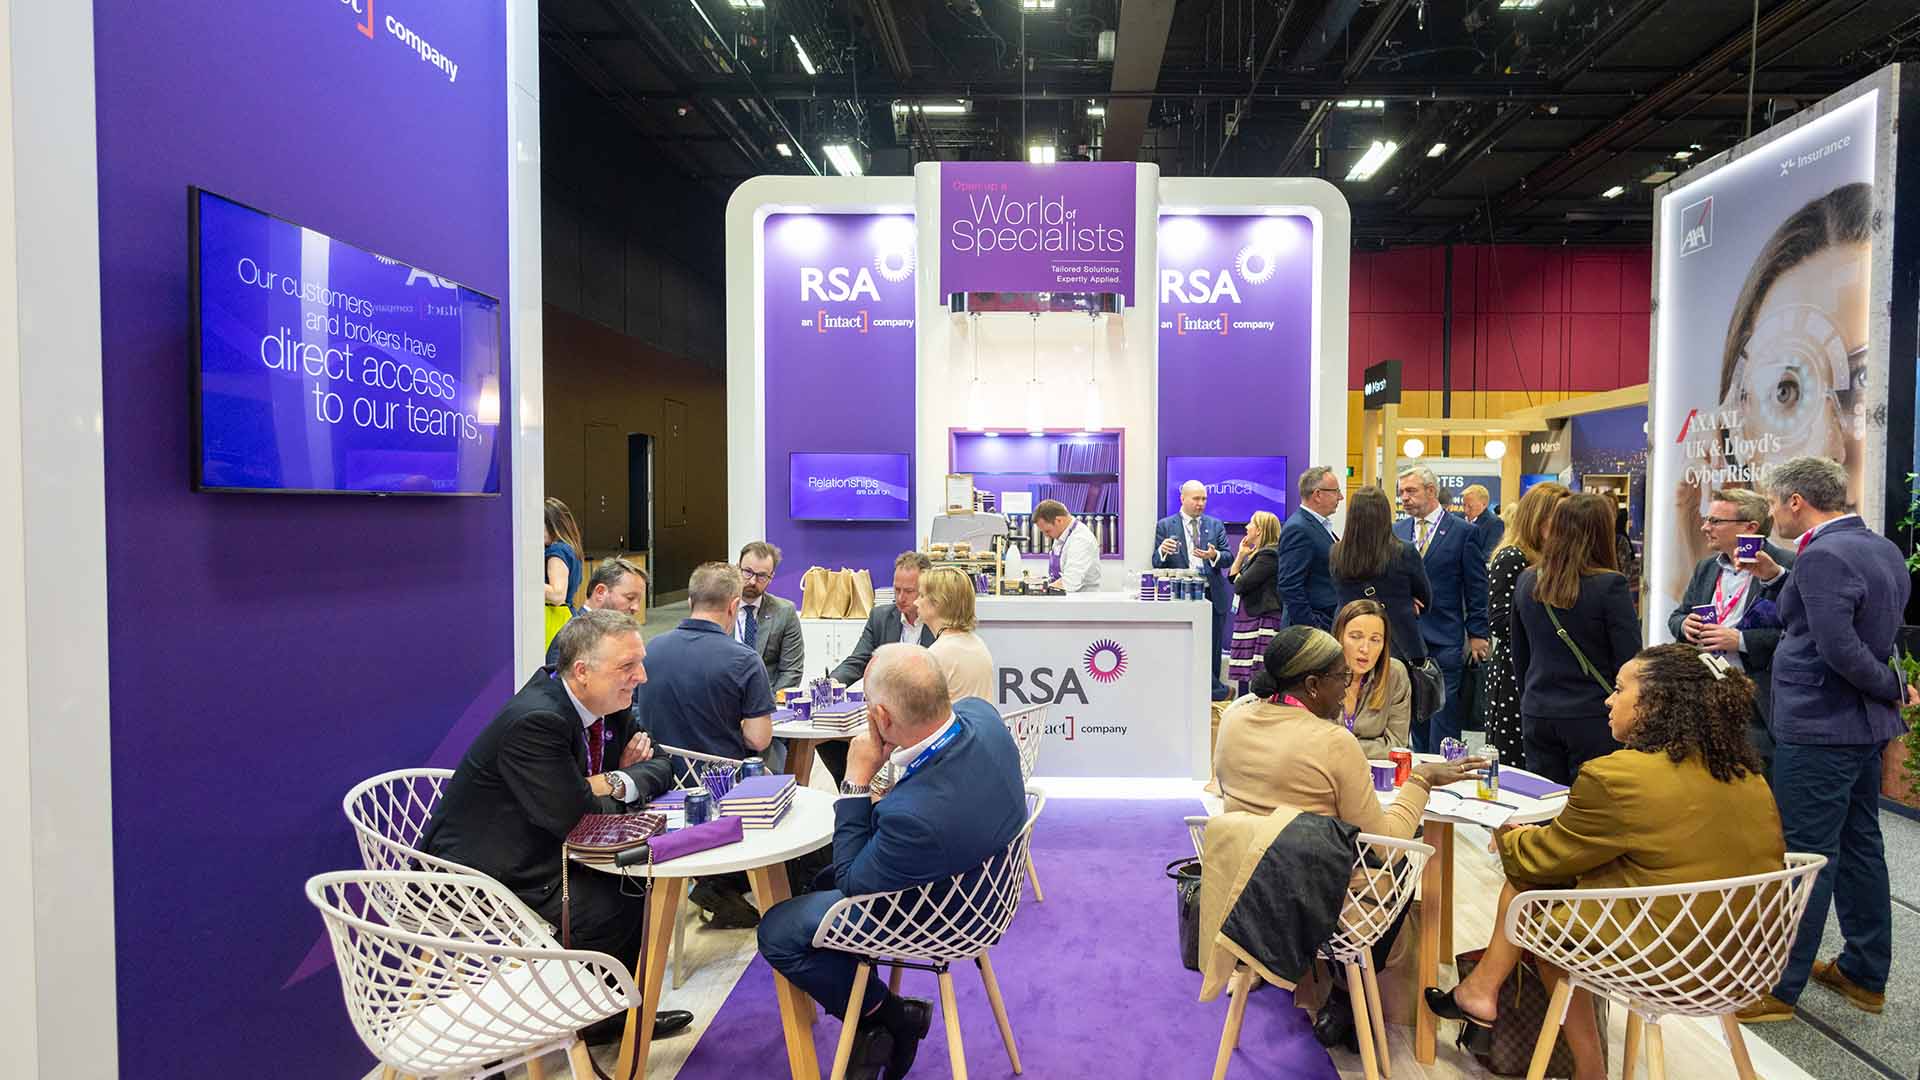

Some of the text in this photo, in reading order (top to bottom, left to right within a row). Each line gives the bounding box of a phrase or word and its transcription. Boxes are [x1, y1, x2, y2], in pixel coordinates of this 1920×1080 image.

[385, 15, 458, 82] company
[1797, 135, 1852, 168] Insurance
[969, 193, 1078, 226] World of
[951, 219, 1125, 257] Specialists
[1682, 225, 1706, 249] AXA
[800, 266, 881, 302] RSA
[1051, 265, 1081, 273] Tailored
[1056, 275, 1121, 284] Expertly Applied.
[238, 257, 277, 290] Our
[281, 275, 373, 318] customers
[1160, 268, 1241, 304] RSA
[306, 311, 437, 359] and brokers have
[801, 319, 814, 328] an
[872, 319, 915, 329] company
[1160, 320, 1173, 329] an
[1232, 320, 1275, 331] company
[261, 326, 456, 400] direct access
[312, 382, 483, 445] to our teams,
[1688, 410, 1743, 433] AXA XL
[1686, 432, 1782, 460] UK & Lloyd's
[808, 476, 879, 489] Relationships
[999, 667, 1089, 705] RSA
[1081, 724, 1128, 736] company
